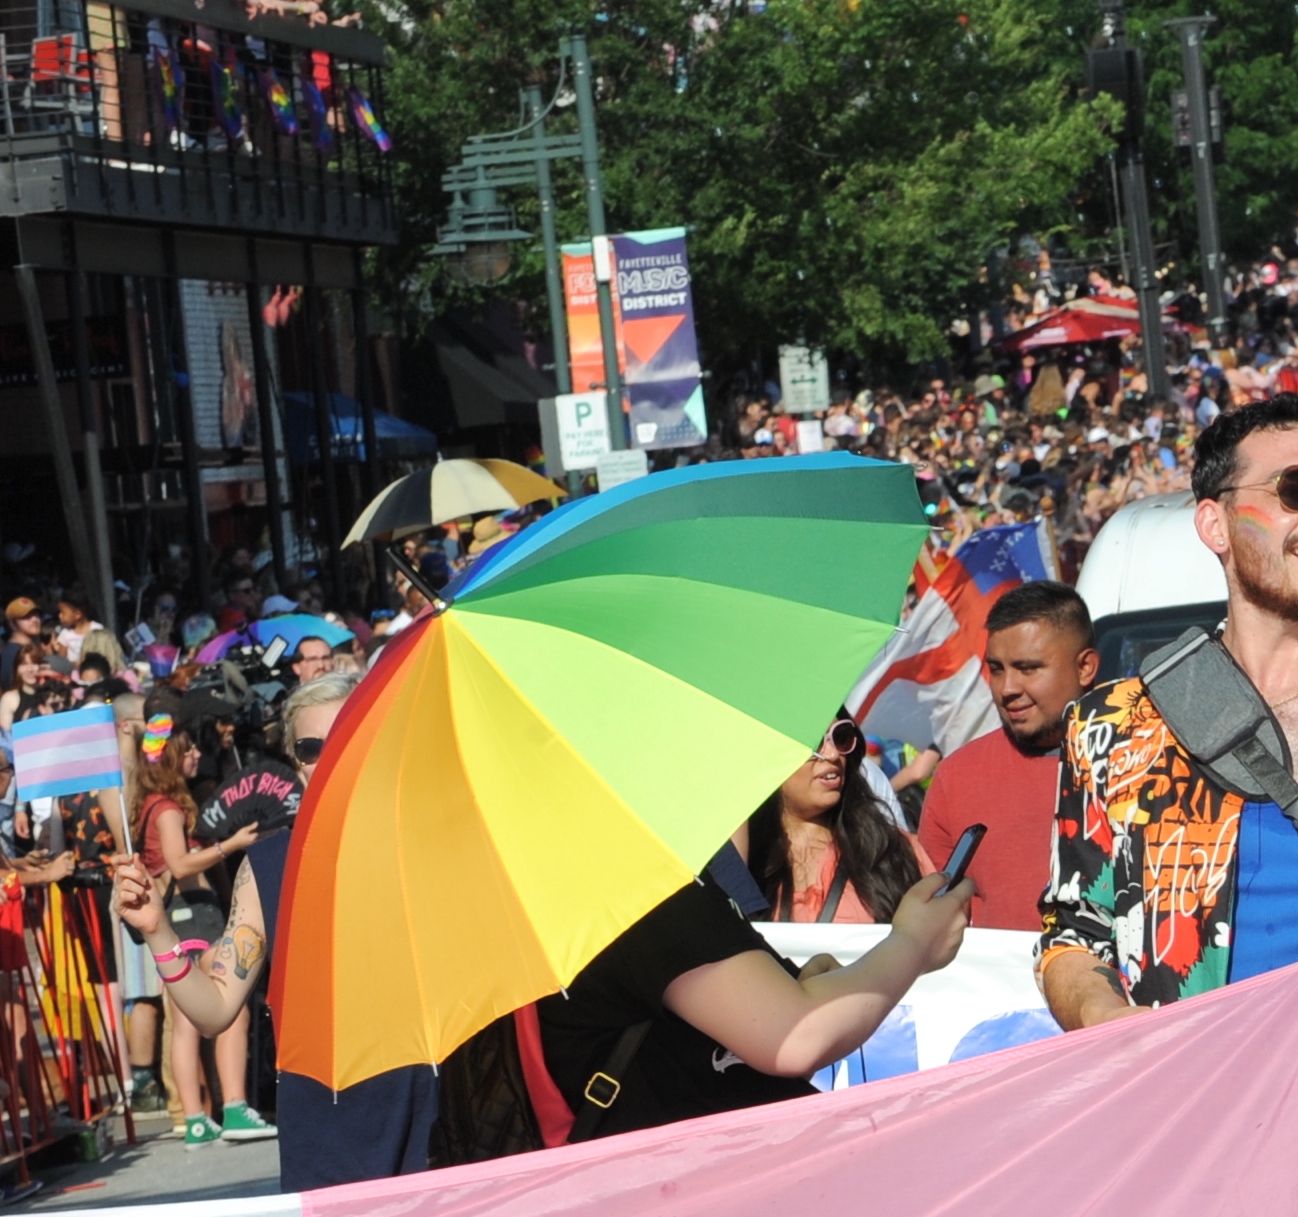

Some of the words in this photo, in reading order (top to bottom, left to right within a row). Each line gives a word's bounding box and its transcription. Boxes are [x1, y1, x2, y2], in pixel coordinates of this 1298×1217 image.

[619, 253, 682, 269] FAYETTEVILLE
[618, 265, 690, 295] MUSIC
[623, 292, 687, 312] DISTRICT
[575, 402, 592, 428] P
